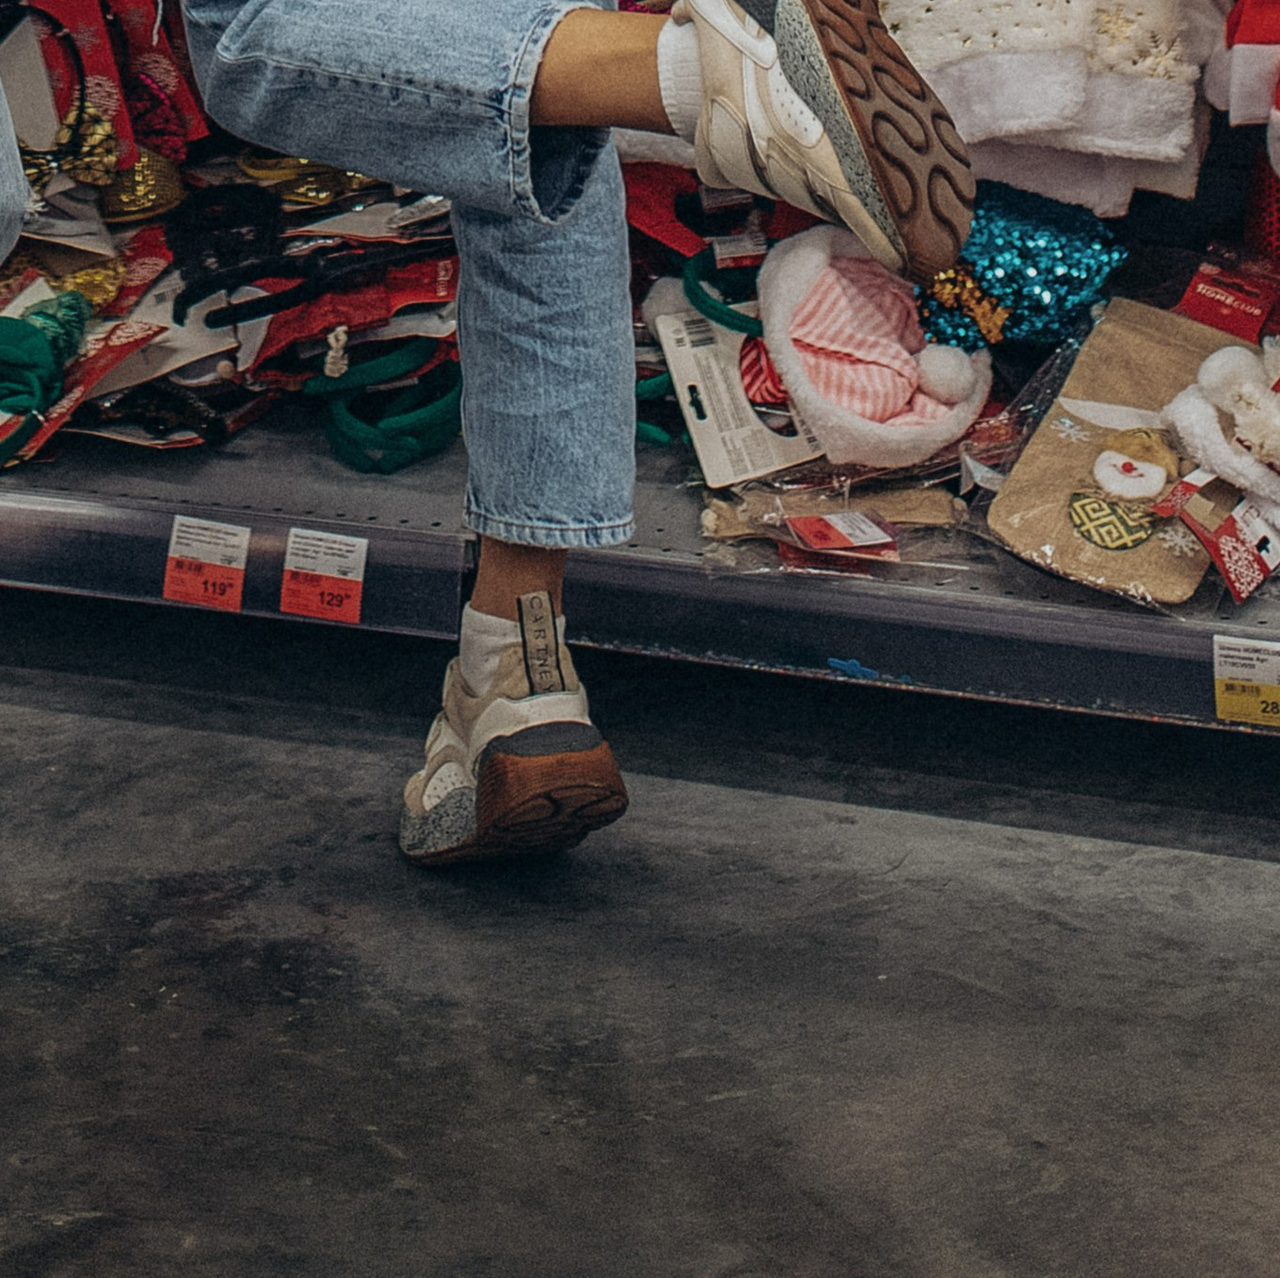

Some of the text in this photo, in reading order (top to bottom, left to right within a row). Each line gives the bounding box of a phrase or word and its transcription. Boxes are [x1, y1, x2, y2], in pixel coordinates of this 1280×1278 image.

[1197, 284, 1262, 316] HOMECLUB
[202, 579, 227, 597] 119
[319, 591, 345, 608] 129
